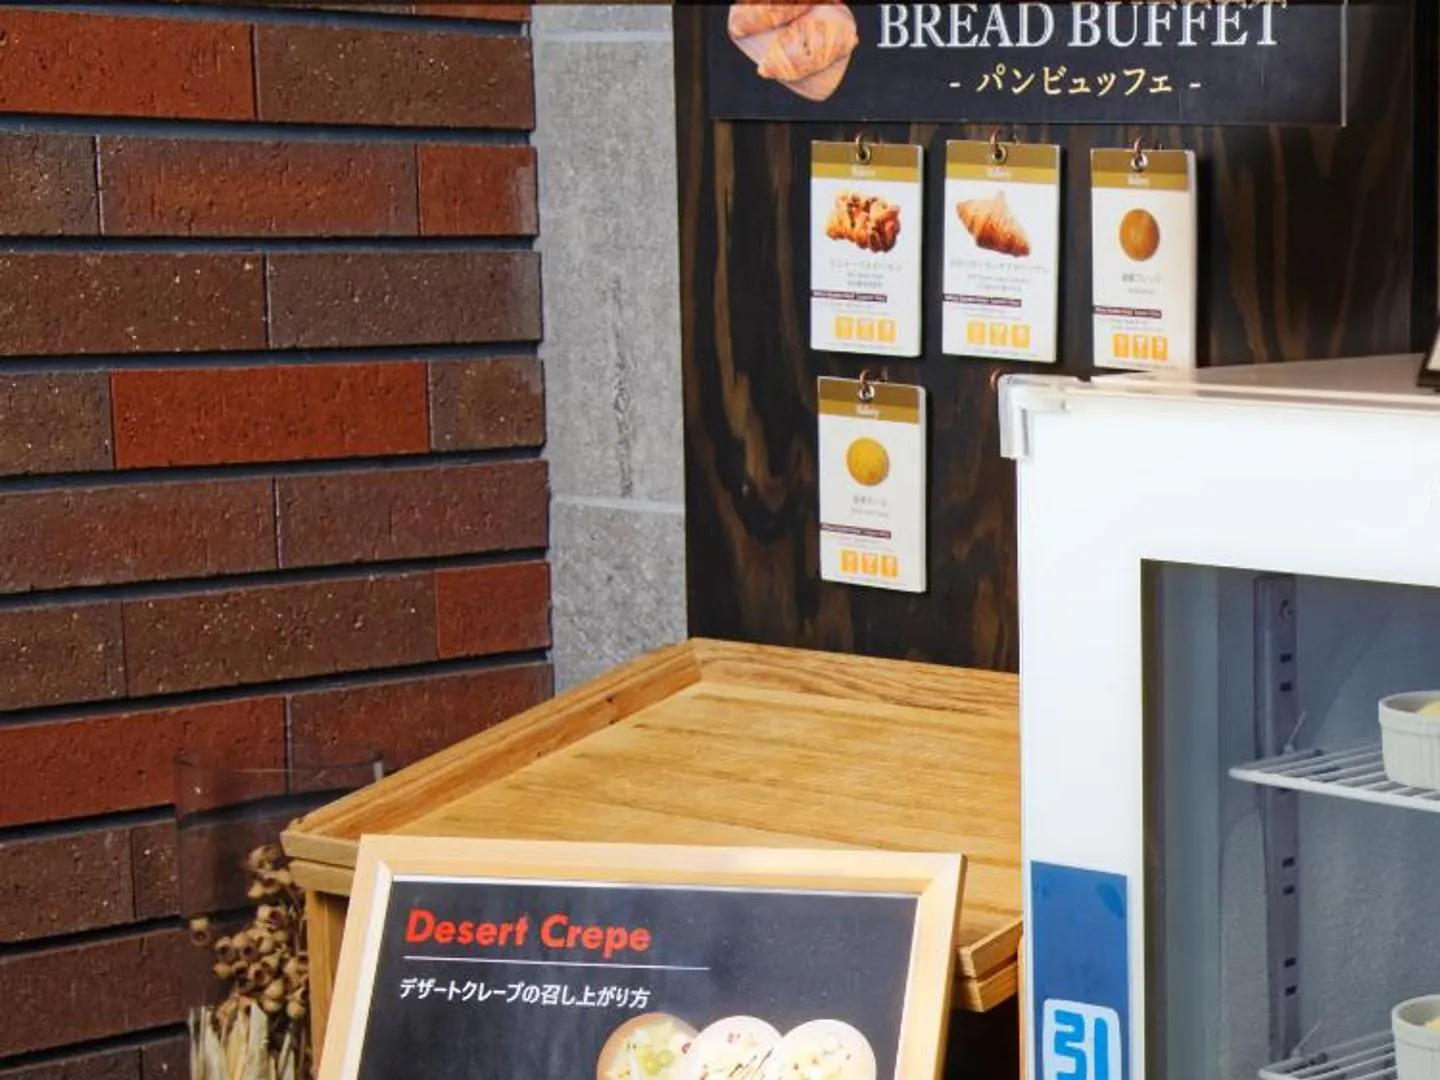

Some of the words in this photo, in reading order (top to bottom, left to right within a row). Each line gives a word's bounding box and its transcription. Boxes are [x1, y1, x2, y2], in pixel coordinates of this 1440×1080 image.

[877, 2, 1056, 48] BREAD
[1067, 1, 1287, 47] BUFFET
[976, 64, 1172, 95] パンビュッフェ
[405, 908, 528, 948] Desert
[541, 912, 652, 959] Crepe
[400, 977, 651, 1009] デザートクレープの召し上がり方
